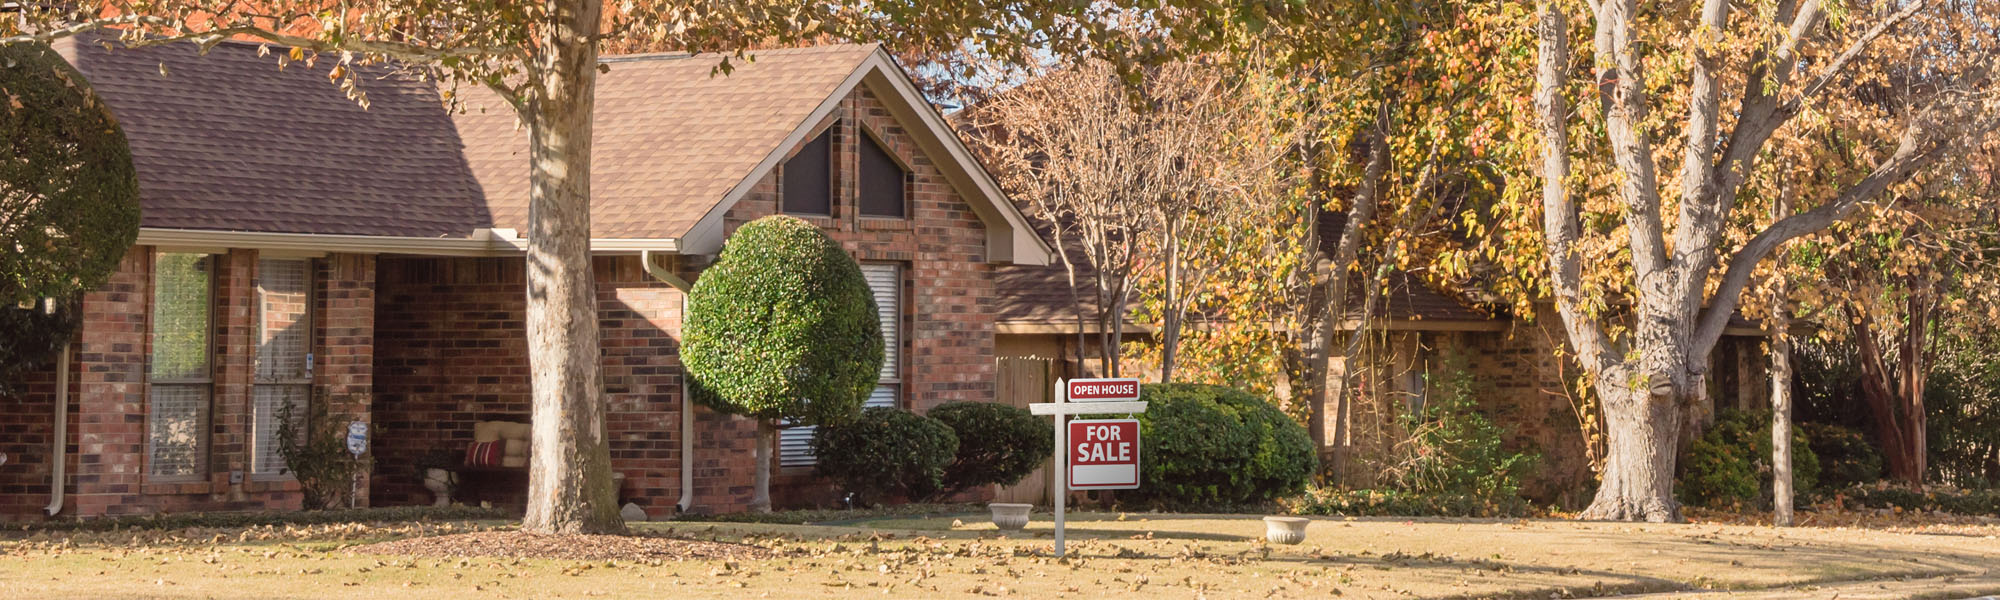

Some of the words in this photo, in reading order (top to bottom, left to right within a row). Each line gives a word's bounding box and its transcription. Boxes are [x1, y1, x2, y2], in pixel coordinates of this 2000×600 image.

[1074, 385, 1099, 395] OPEN
[1102, 384, 1134, 394] HOUSE
[1086, 425, 1121, 441] FOR
[1078, 442, 1130, 462] SALE
